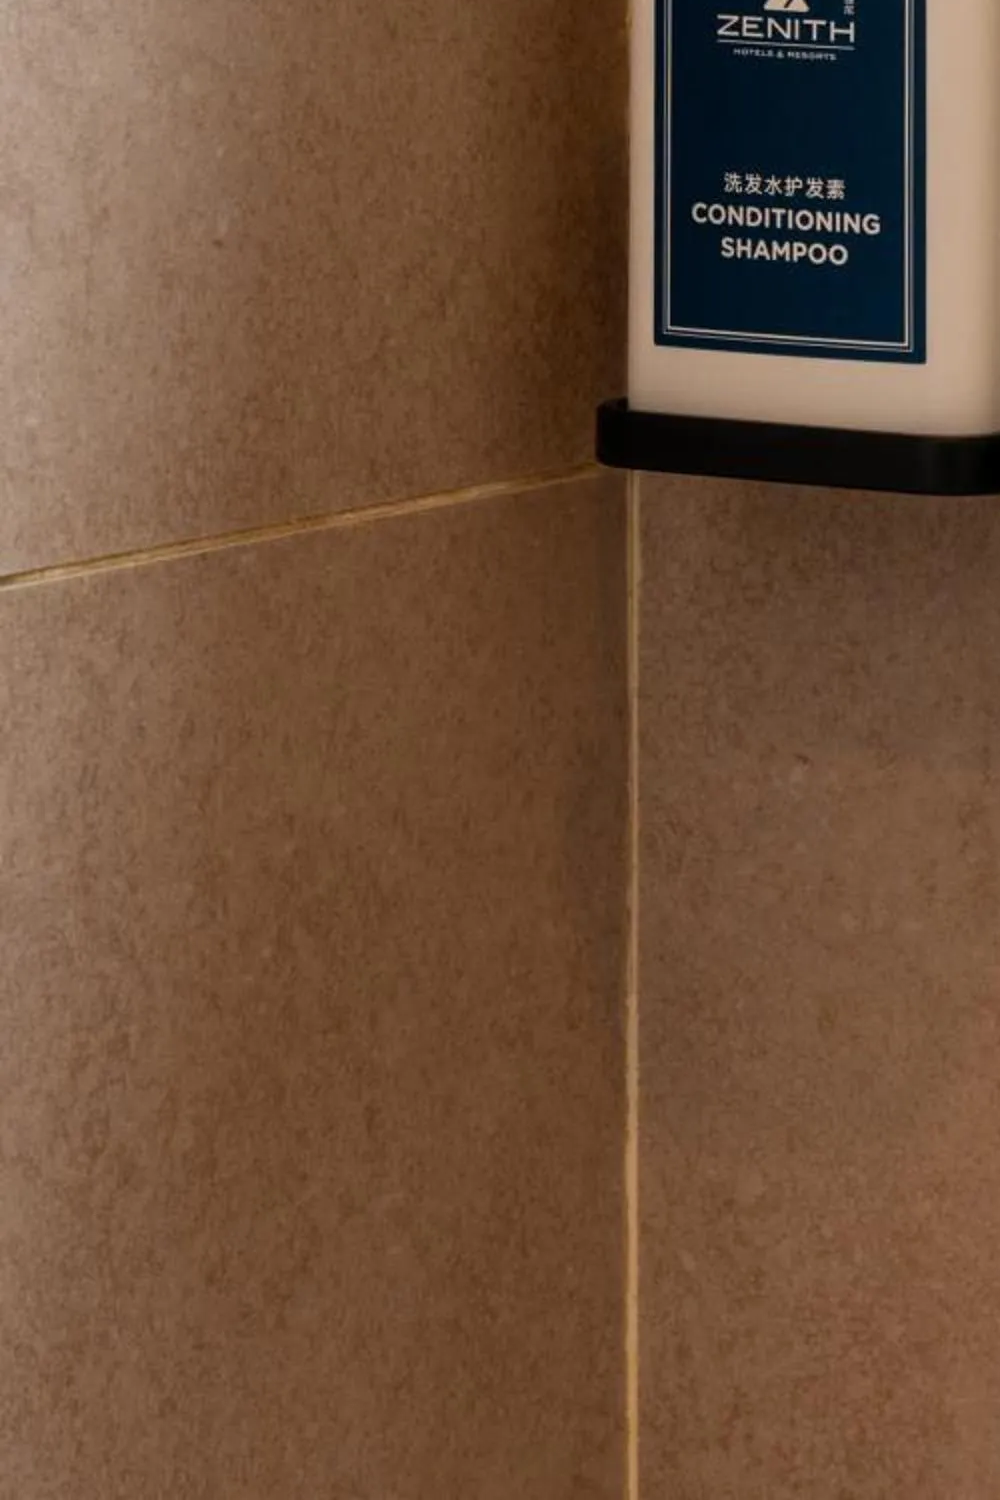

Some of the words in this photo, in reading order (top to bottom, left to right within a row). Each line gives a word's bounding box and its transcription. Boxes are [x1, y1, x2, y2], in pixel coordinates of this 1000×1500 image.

[716, 13, 855, 43] ZENITH
[733, 48, 774, 57] HOTELS
[787, 51, 837, 61] RESORTS
[724, 172, 846, 200] 洗发水护发素
[691, 202, 881, 236] CONDITIONING
[720, 236, 849, 265] SHAMPOO
